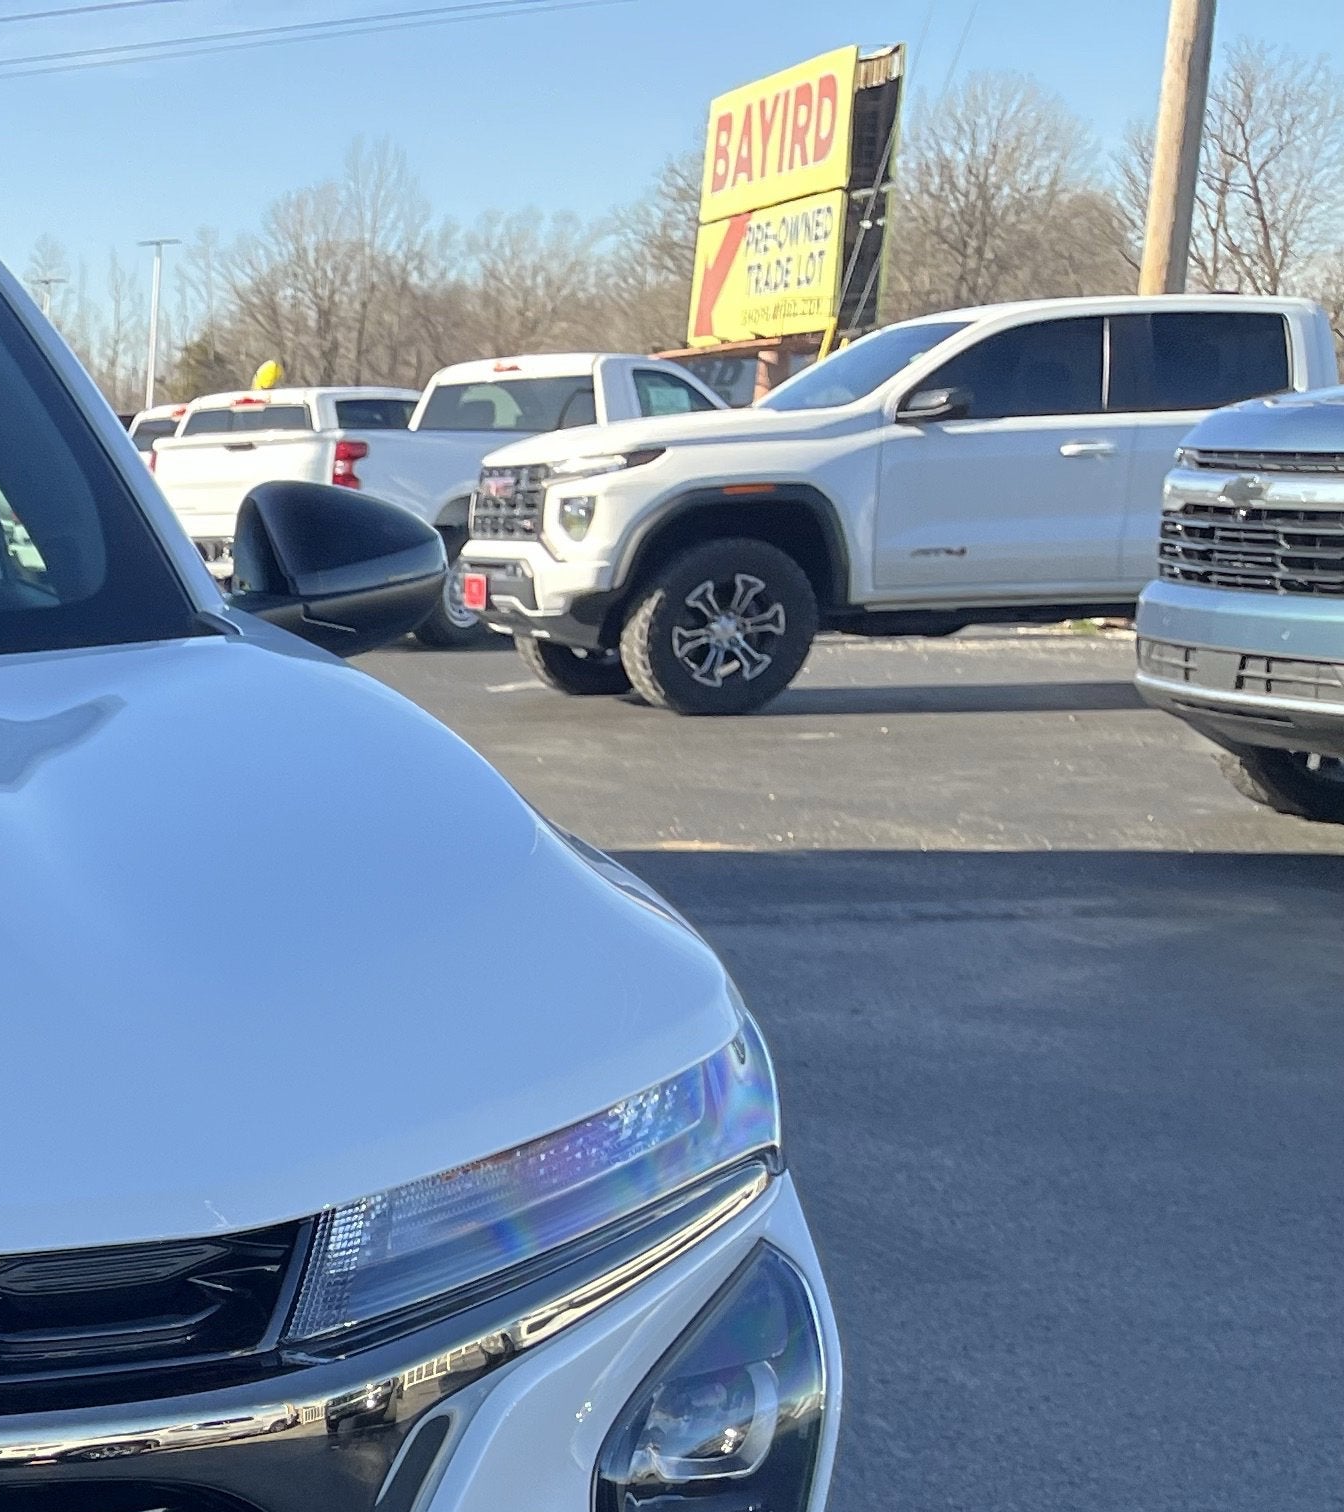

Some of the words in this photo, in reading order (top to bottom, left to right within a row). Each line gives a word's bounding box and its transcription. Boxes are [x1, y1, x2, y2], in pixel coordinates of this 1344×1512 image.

[710, 73, 838, 194] BAYIRD
[745, 206, 834, 257] PRE-OWNED
[746, 256, 792, 296] TRADE
[796, 250, 826, 288] LOT
